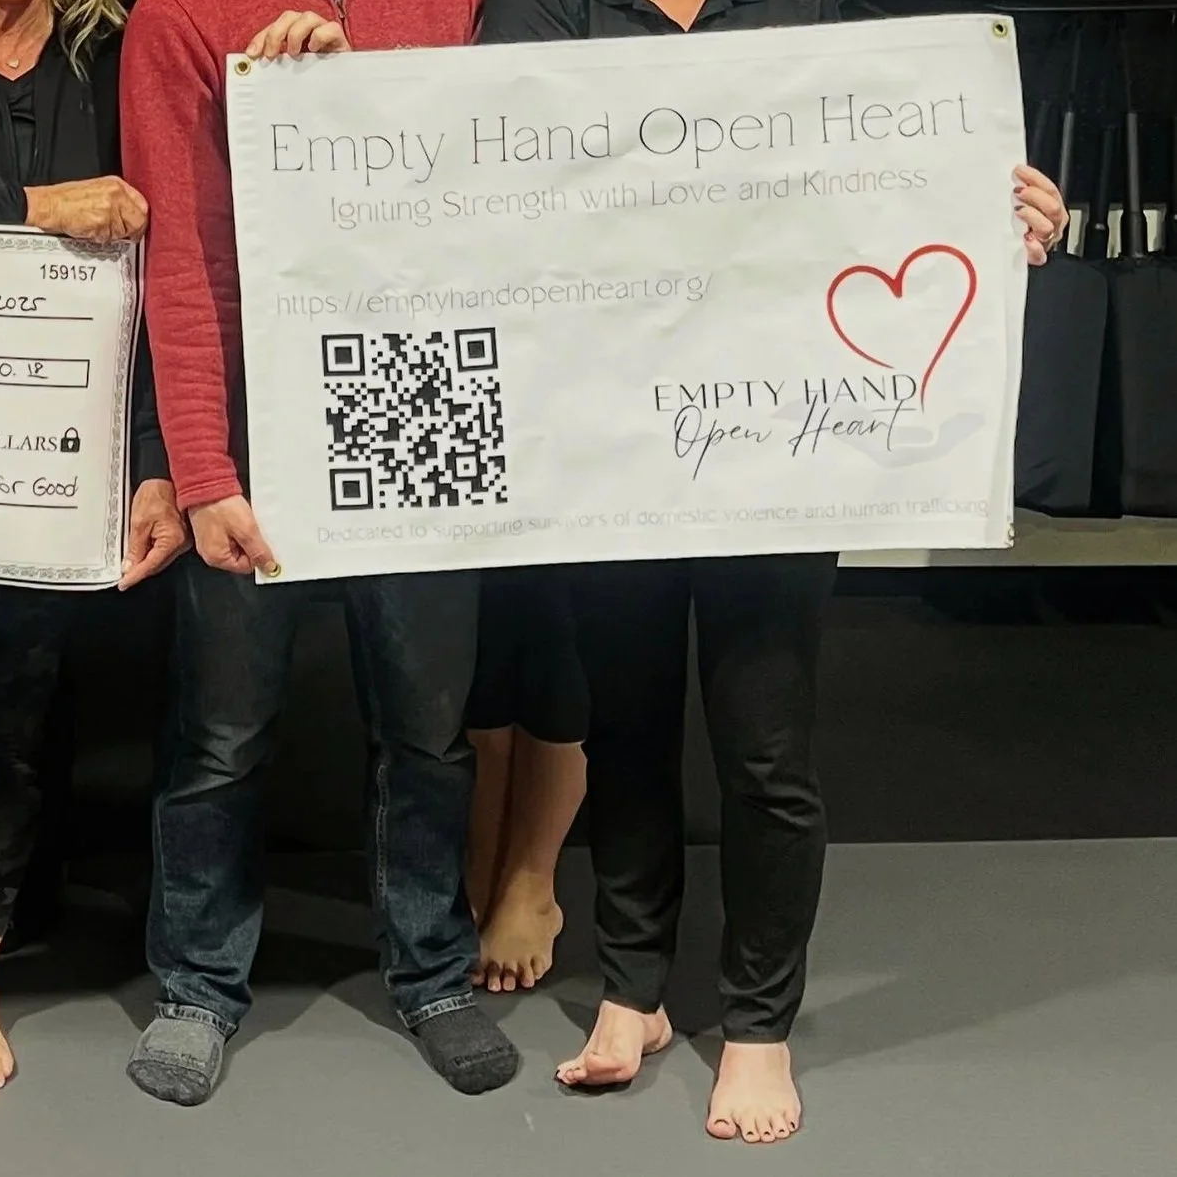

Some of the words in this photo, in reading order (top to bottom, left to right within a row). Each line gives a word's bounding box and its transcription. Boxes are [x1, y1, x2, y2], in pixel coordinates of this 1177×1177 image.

[270, 122, 446, 186] Empty
[471, 111, 613, 165] Hand
[639, 106, 796, 169] Open
[819, 92, 975, 144] Heart
[330, 196, 432, 230] Igniting
[442, 185, 568, 220] Strength
[579, 182, 638, 211] with
[651, 180, 727, 207] Love
[738, 173, 790, 202] and
[803, 166, 929, 197] Kindness
[39, 263, 97, 282] 159157
[276, 272, 713, 318] https://emptyhandopenheartorg/
[654, 380, 785, 412] EMPTY
[804, 374, 917, 406] HAND
[674, 404, 773, 481] Open
[787, 393, 917, 458] Heart
[32, 475, 79, 497] Good
[410, 523, 427, 539] to
[613, 509, 631, 526] of
[804, 503, 837, 520] and
[842, 500, 900, 518] human
